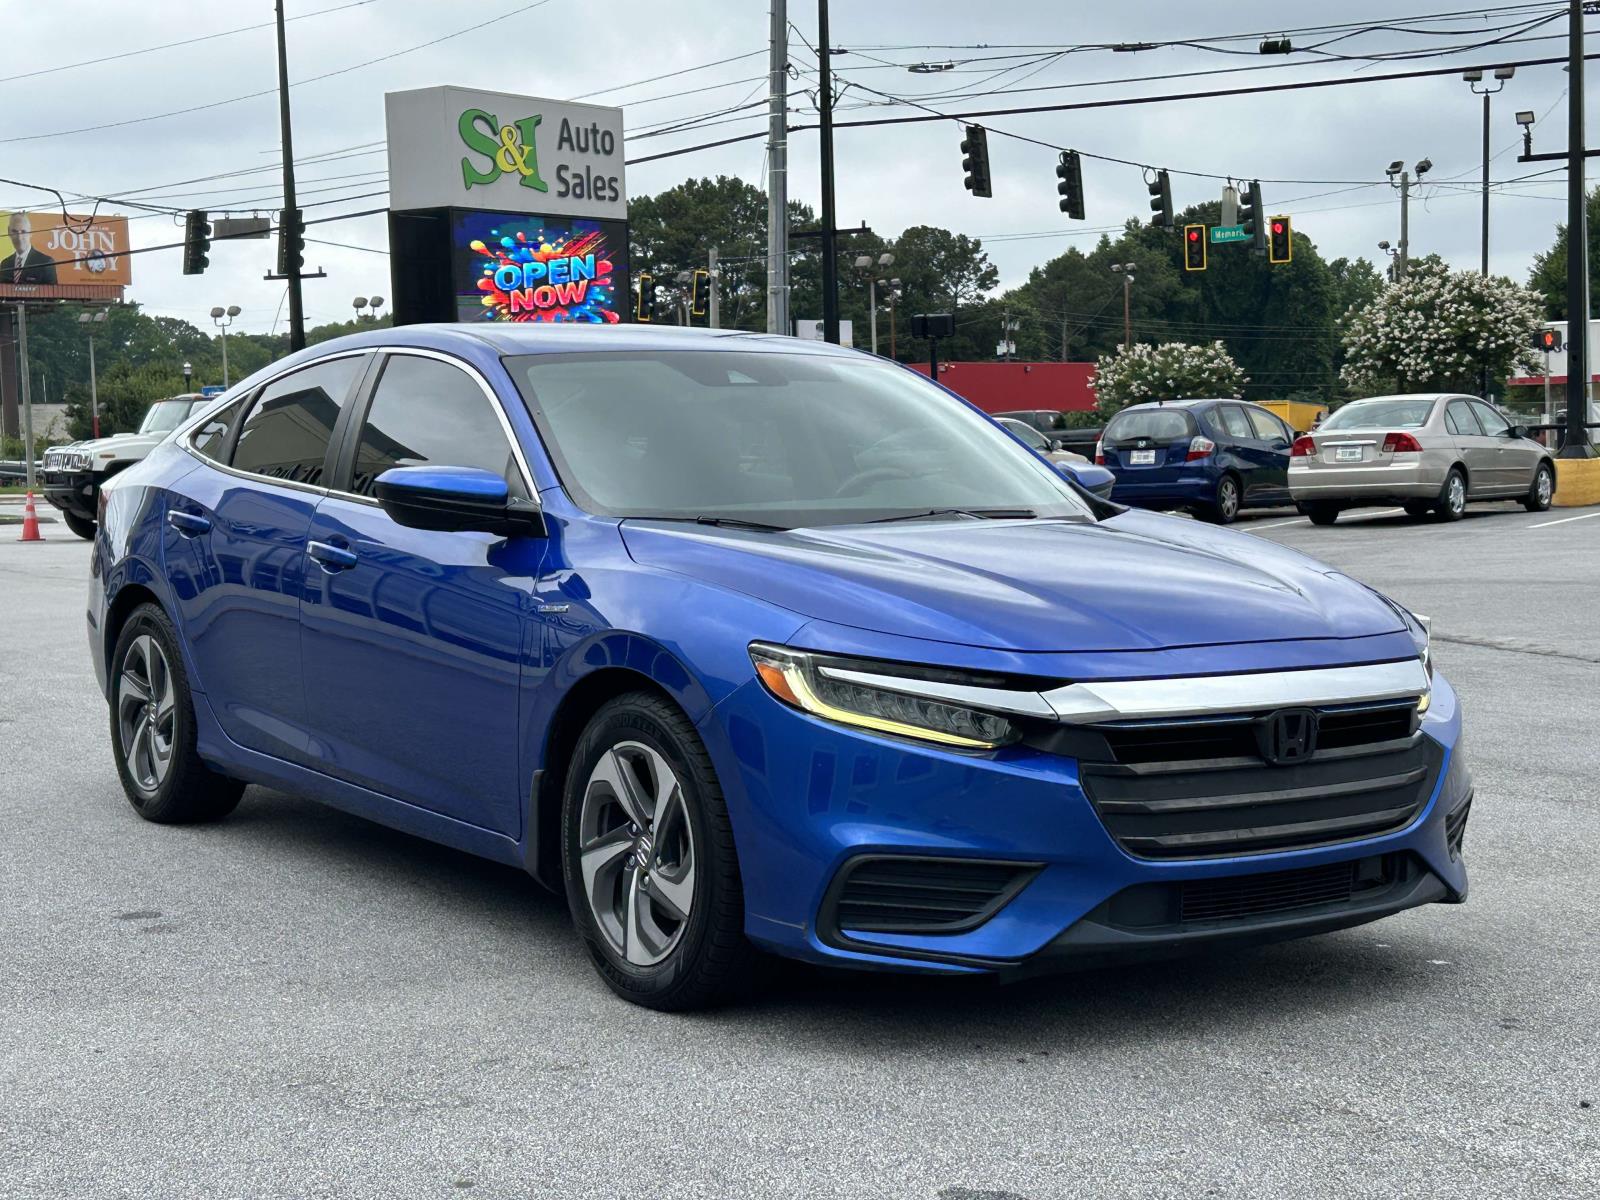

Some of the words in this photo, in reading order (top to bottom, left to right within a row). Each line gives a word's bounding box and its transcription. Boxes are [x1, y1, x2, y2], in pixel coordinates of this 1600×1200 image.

[458, 108, 548, 193] S&I
[557, 118, 615, 156] Auto
[556, 164, 619, 201] Sales
[47, 229, 116, 251] JOHN
[494, 253, 596, 291] OPEN
[510, 279, 589, 313] NOW
